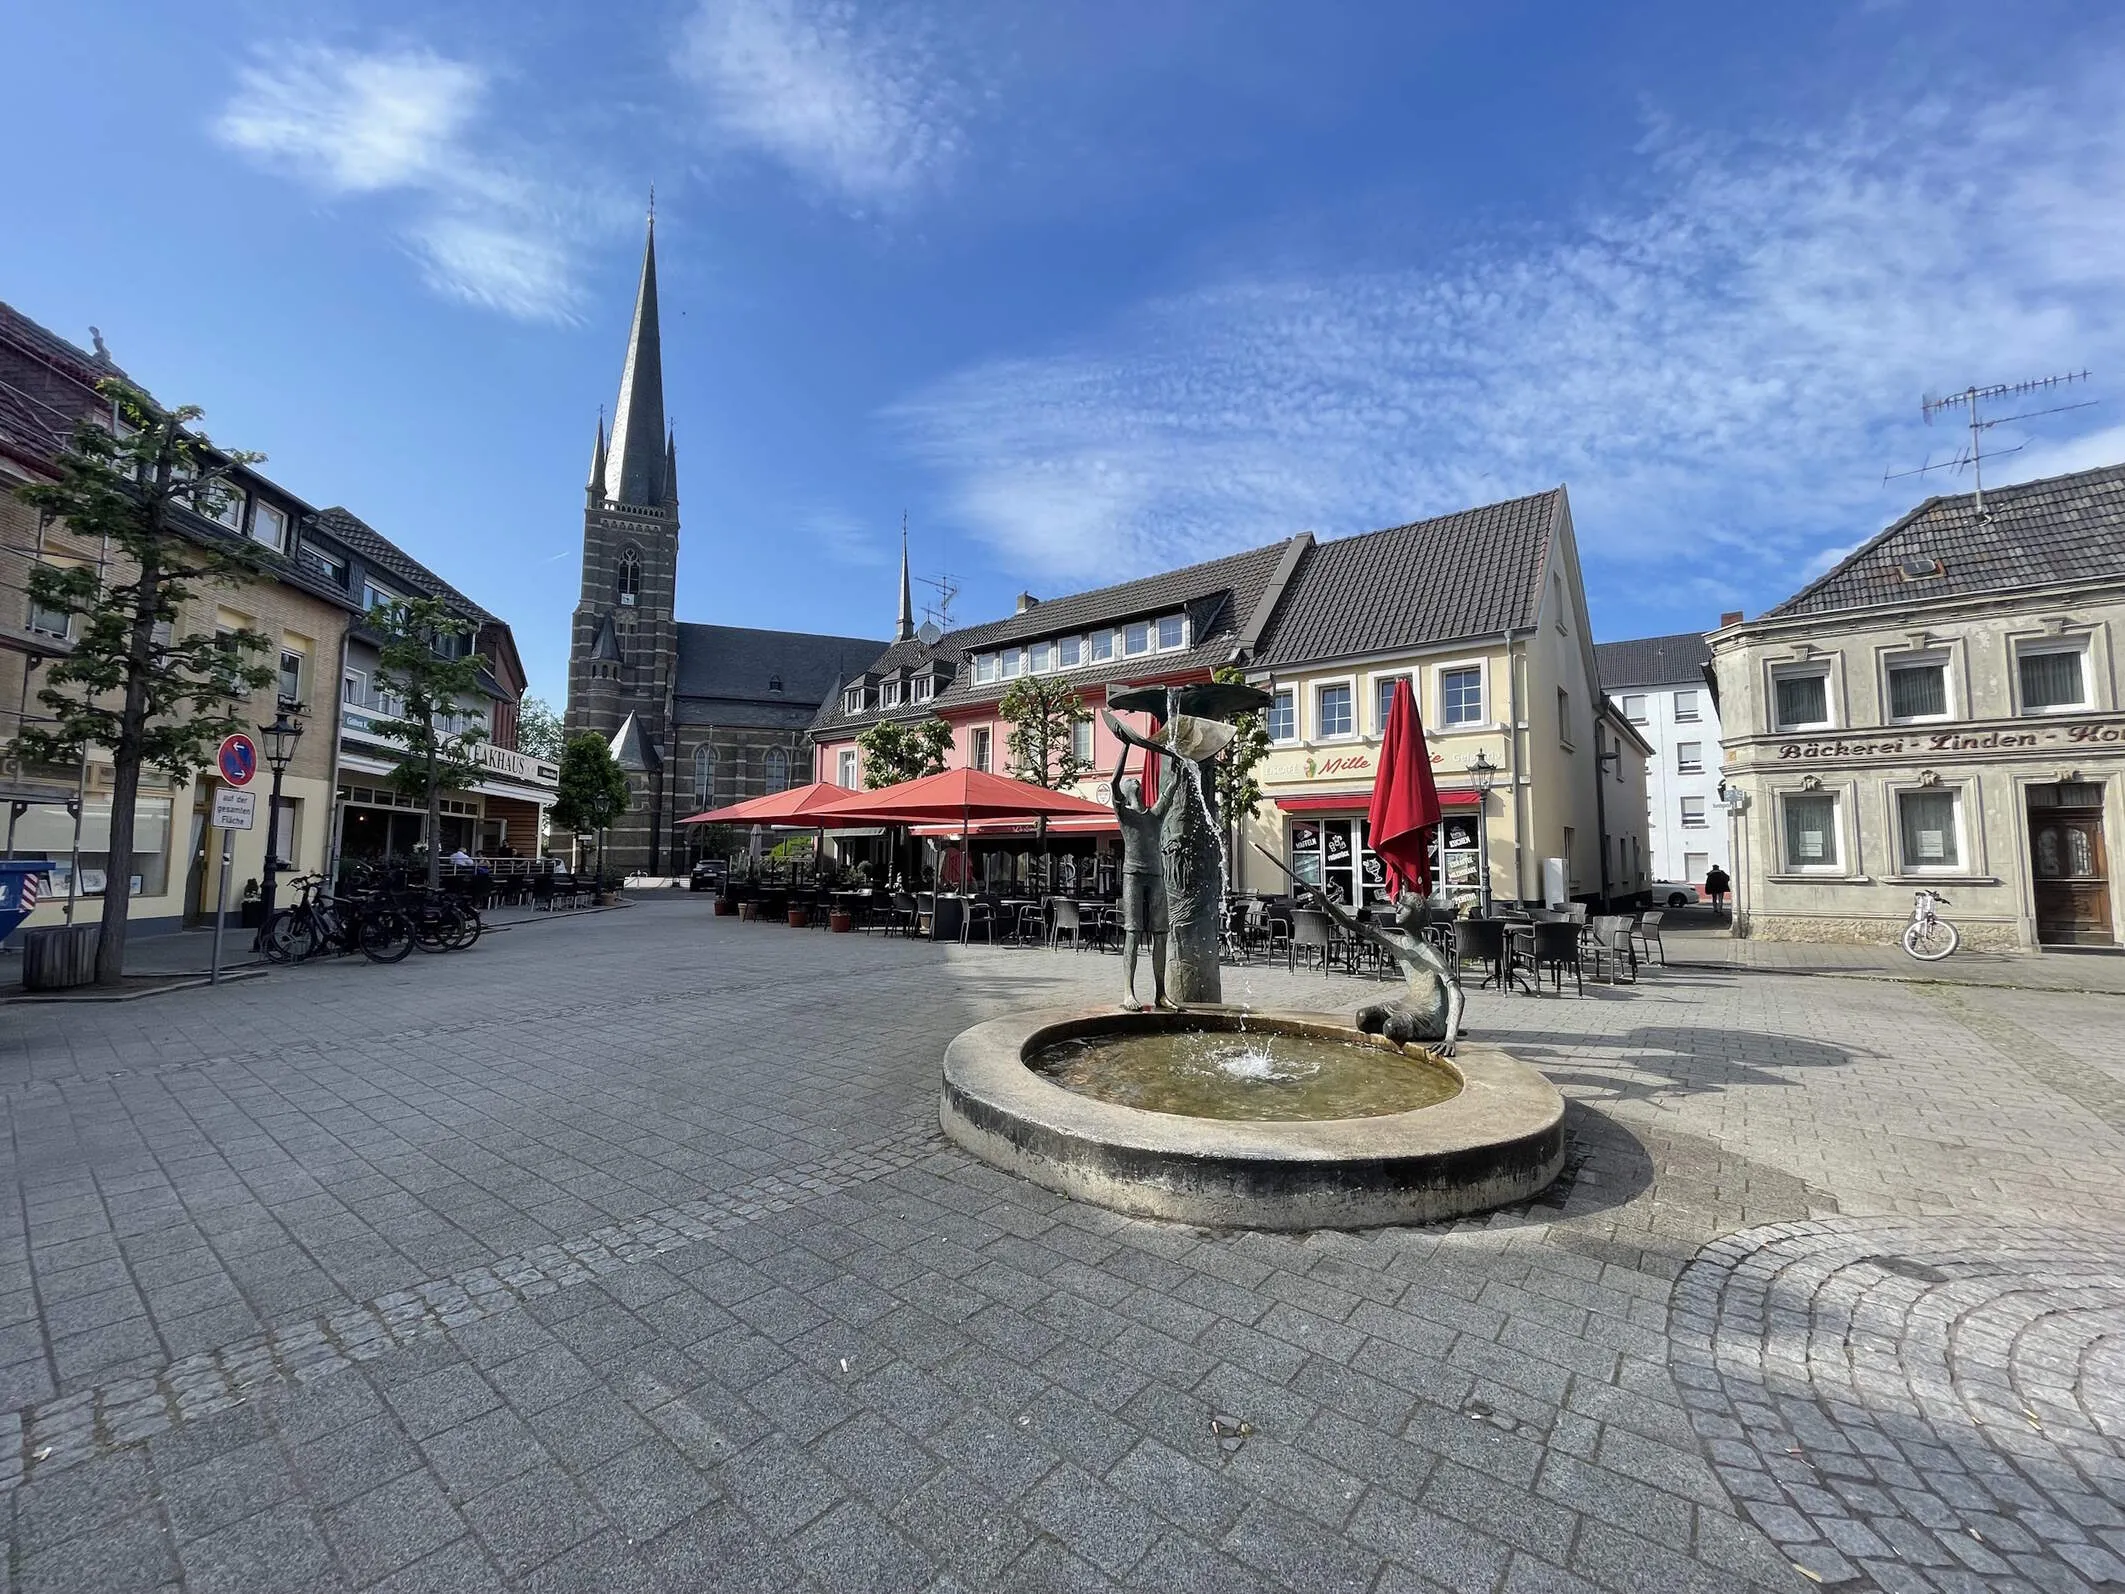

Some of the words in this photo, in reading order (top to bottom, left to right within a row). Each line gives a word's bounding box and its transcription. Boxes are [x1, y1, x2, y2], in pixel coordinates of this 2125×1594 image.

[1777, 738, 1904, 759] Bäckerei
[1928, 731, 2037, 751] Linden
[1318, 755, 1372, 775] Mille
[223, 794, 234, 802] auf
[217, 805, 251, 815] gesamten
[221, 815, 244, 825] Fläche
